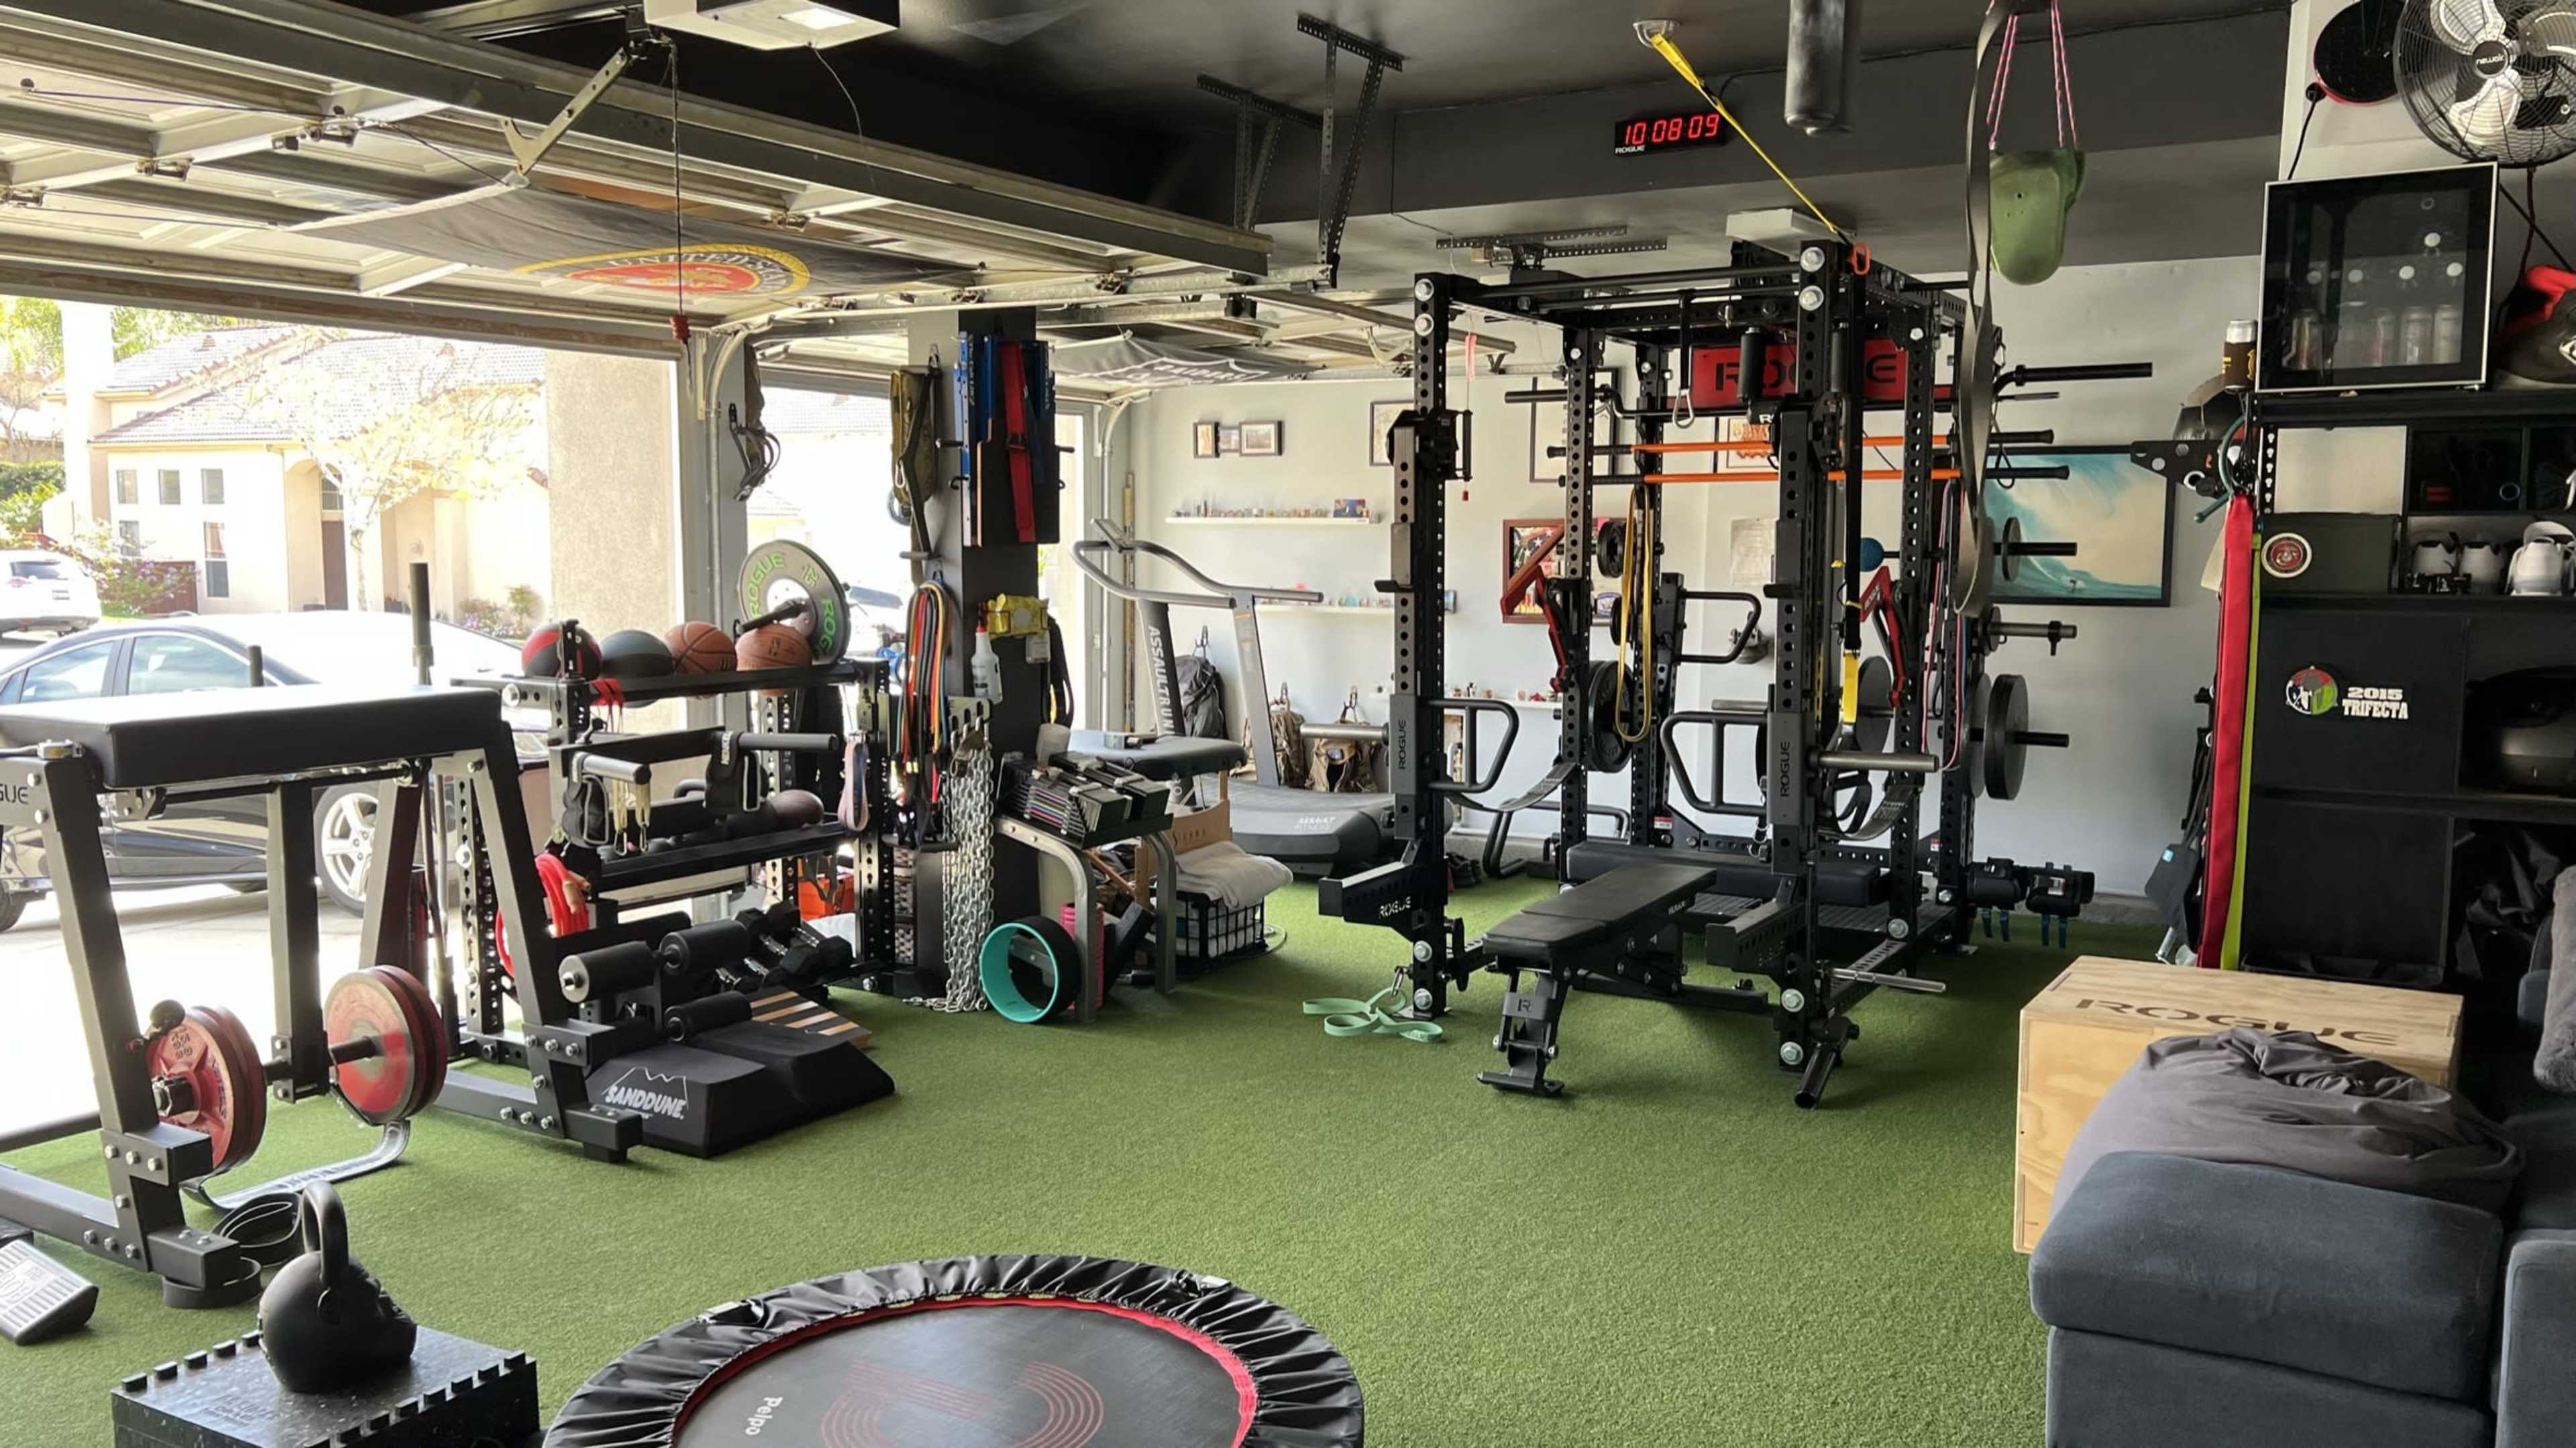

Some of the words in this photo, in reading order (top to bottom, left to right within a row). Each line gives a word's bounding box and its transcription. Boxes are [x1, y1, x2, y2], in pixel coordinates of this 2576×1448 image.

[1615, 145, 1645, 154] ROGUE
[817, 598, 837, 656] ROG
[2341, 698, 2410, 720] TRIFECTA
[2347, 686, 2404, 701] 2015
[1397, 719, 1407, 770] ROGUE
[1780, 740, 1790, 797] ROGUE
[745, 1396, 784, 1436] Pelpo
